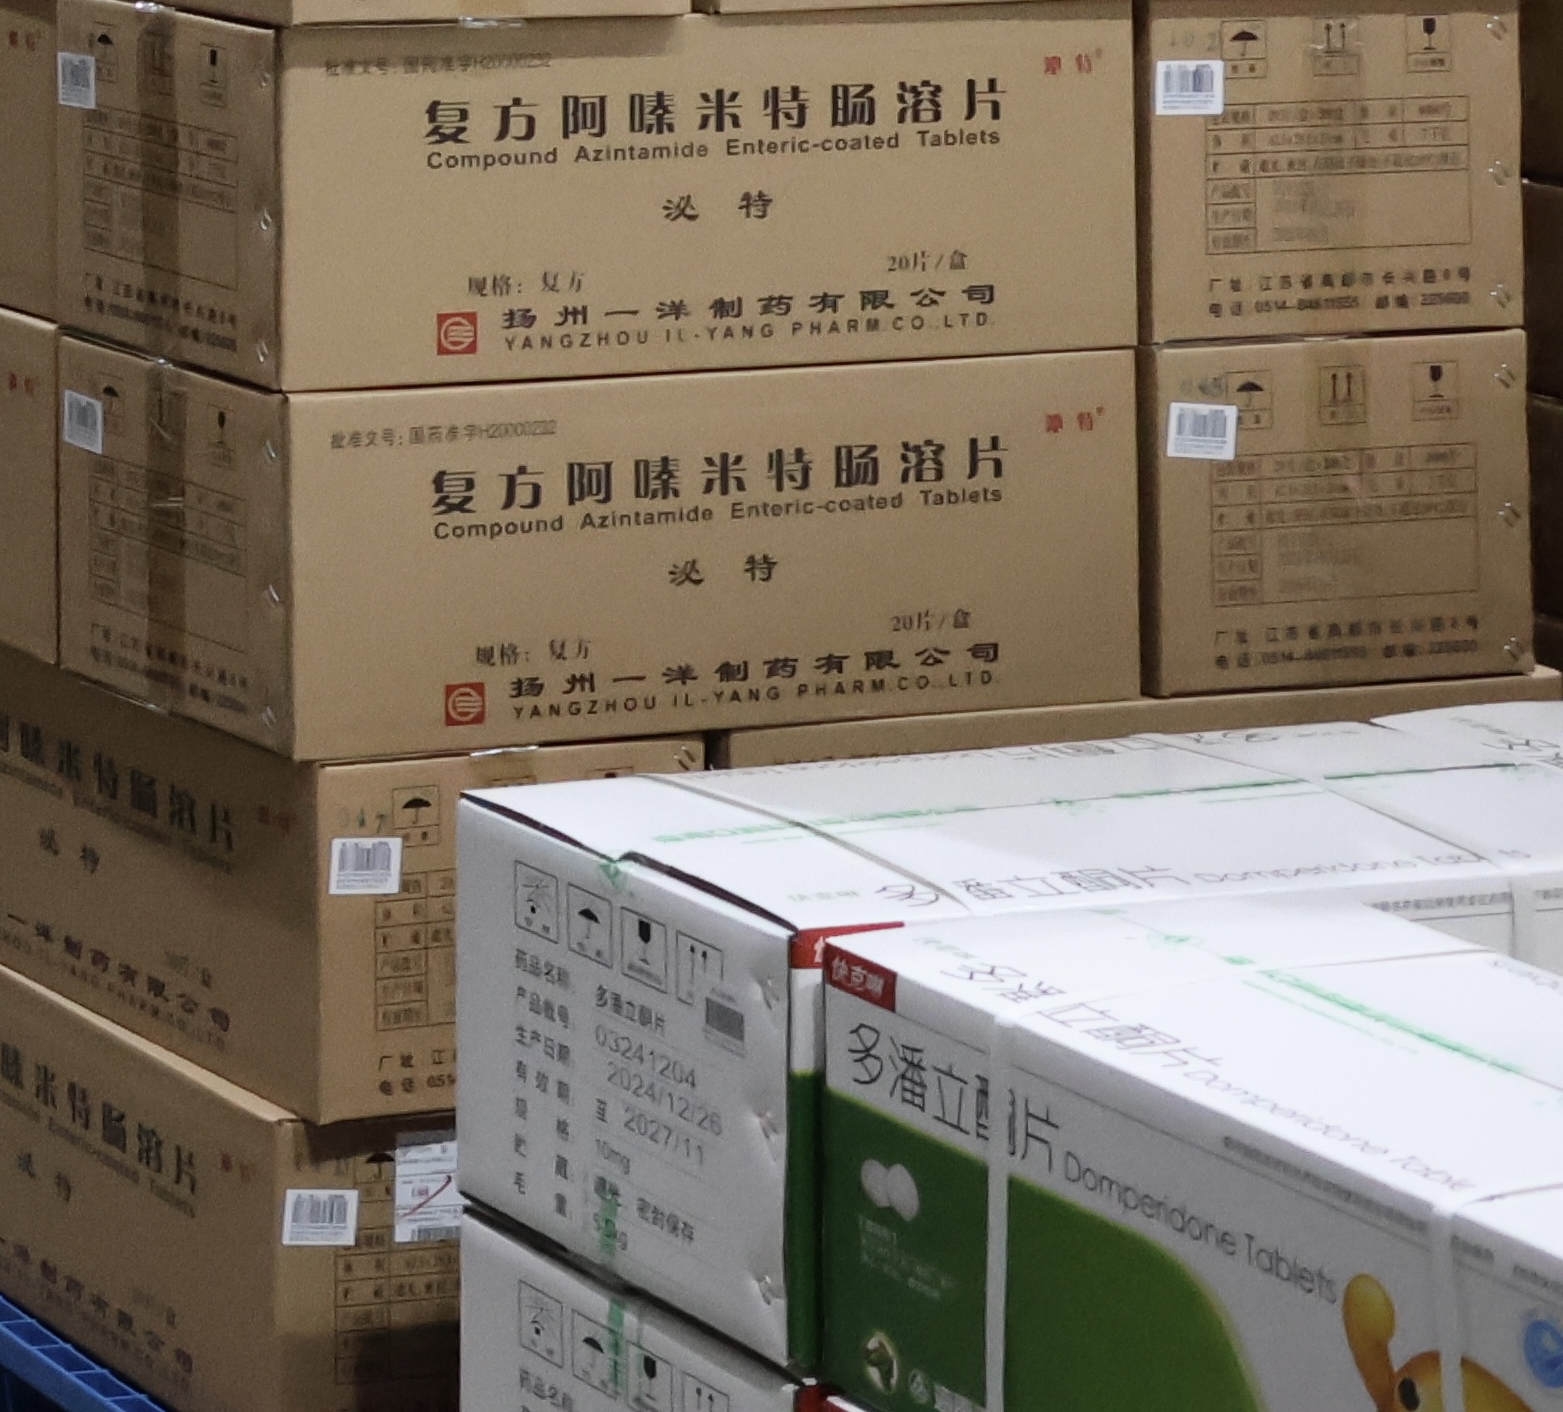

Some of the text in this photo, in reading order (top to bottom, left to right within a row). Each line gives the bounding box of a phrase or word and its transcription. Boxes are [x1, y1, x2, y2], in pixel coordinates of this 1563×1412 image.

[425, 78, 1007, 146] 复方阿嗪米特肠溶片
[427, 129, 1000, 170] Compound Azintamide Enteric-coated Tablets
[501, 284, 995, 329] 扬州一洋制药有限公司
[506, 330, 650, 351] YANGZHOU
[432, 436, 1008, 516] 复方阿嗪米特肠溶片
[434, 487, 1003, 540] Compound Azintamide Enteric-coated Tablets
[509, 642, 999, 698] 扬州一洋制药有限公司
[513, 695, 657, 720] YANGZHOU
[1064, 1151, 1336, 1305] Domperidone Tablets
